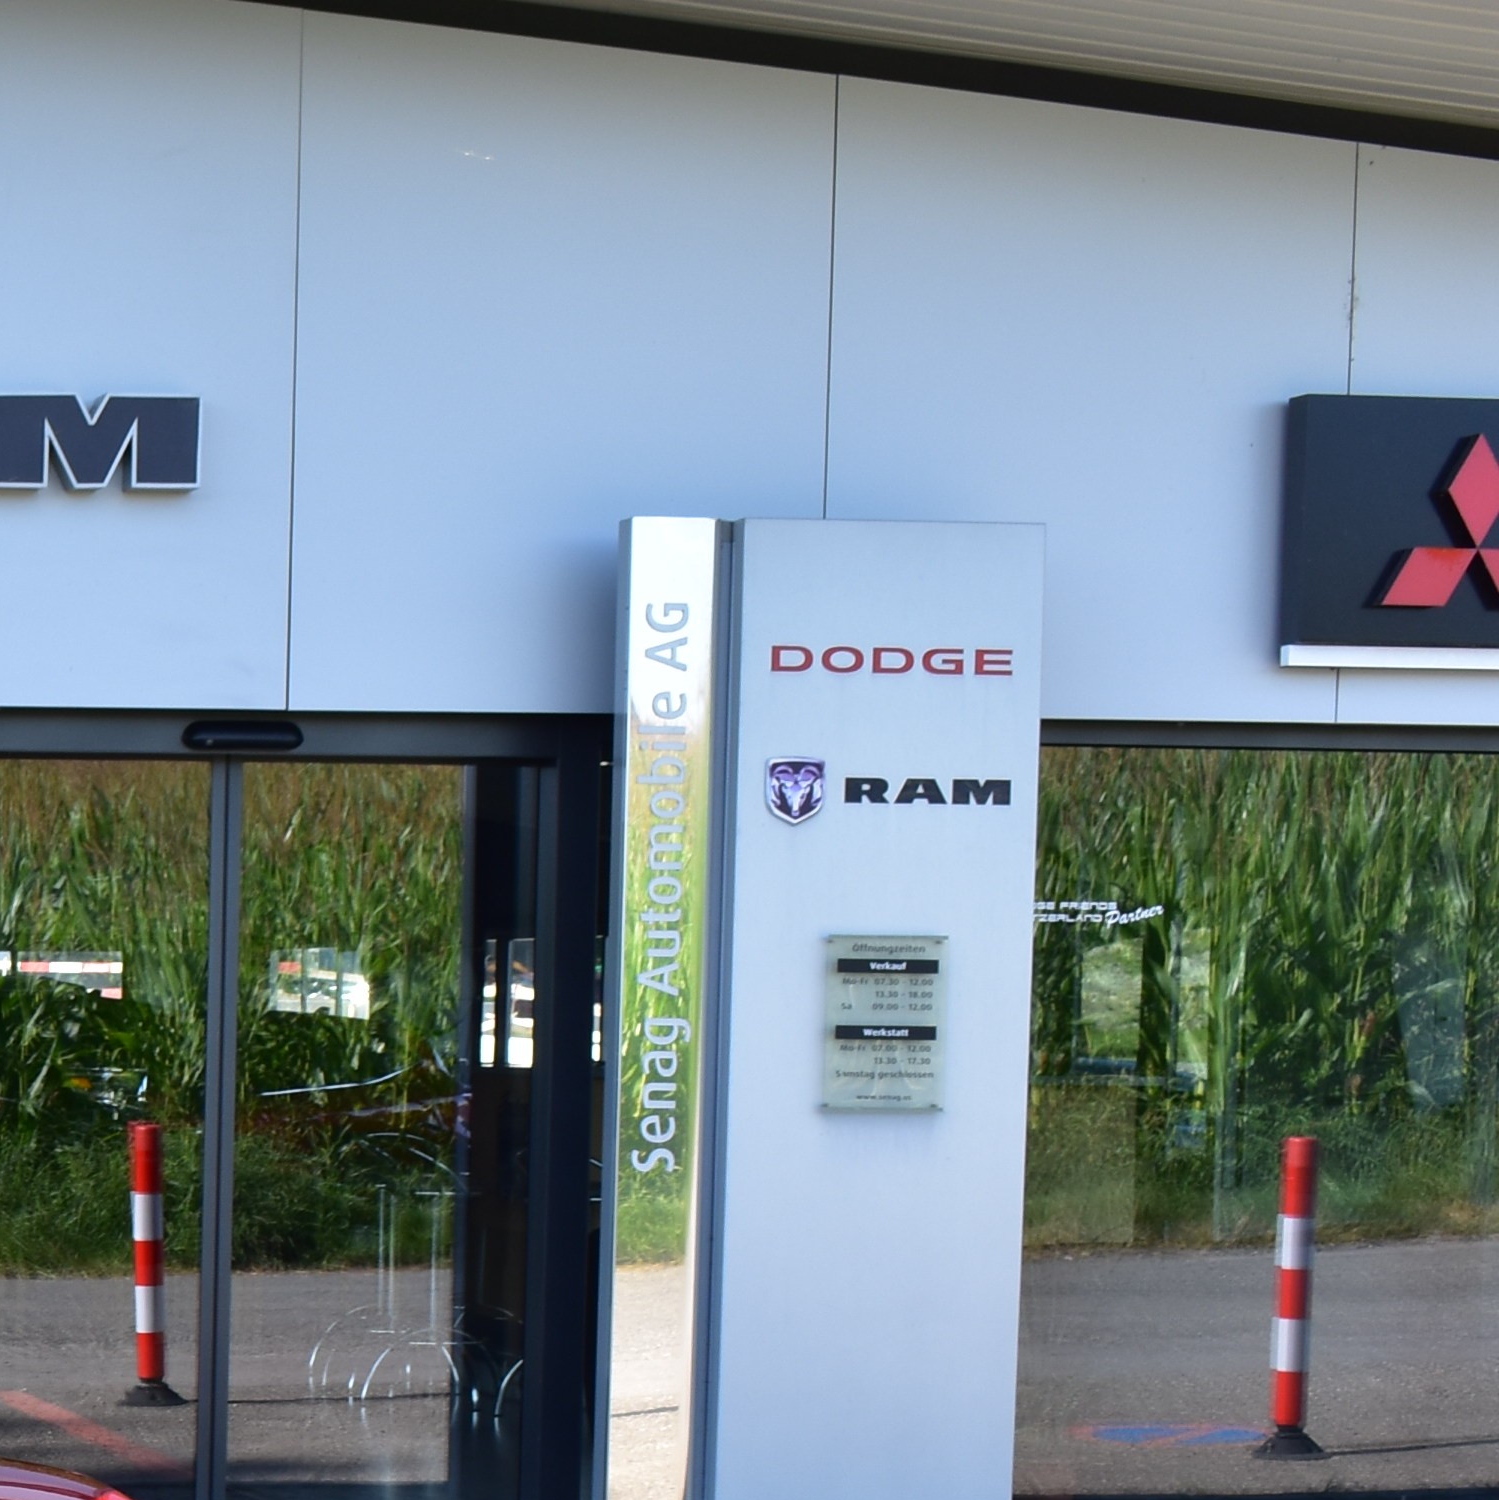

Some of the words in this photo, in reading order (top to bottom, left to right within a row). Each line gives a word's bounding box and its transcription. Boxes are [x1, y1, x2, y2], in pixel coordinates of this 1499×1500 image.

[644, 602, 690, 672] AG
[770, 644, 1014, 677] DODGE
[843, 776, 1012, 806] RAM
[636, 689, 688, 997] Automobile
[1104, 904, 1165, 930] Partner
[868, 960, 908, 971] Verkauf
[842, 977, 869, 986] Mo-Fr
[874, 977, 900, 986] 07.30
[909, 978, 935, 986] 12.00
[875, 990, 899, 999] 13.30
[908, 991, 934, 999] 18.00
[840, 1002, 853, 1010] Sa
[871, 1002, 900, 1011] 09.00
[908, 1003, 934, 1011] 12.00
[862, 1028, 910, 1037] Werkstatt
[839, 1044, 866, 1052] Mo-Fr
[870, 1044, 898, 1052] 07.00
[907, 1045, 933, 1053] 12.00
[873, 1057, 898, 1065] 13.30
[907, 1057, 932, 1065] 17.30
[877, 1070, 935, 1080] geschlossen
[630, 1014, 692, 1174] Senag
